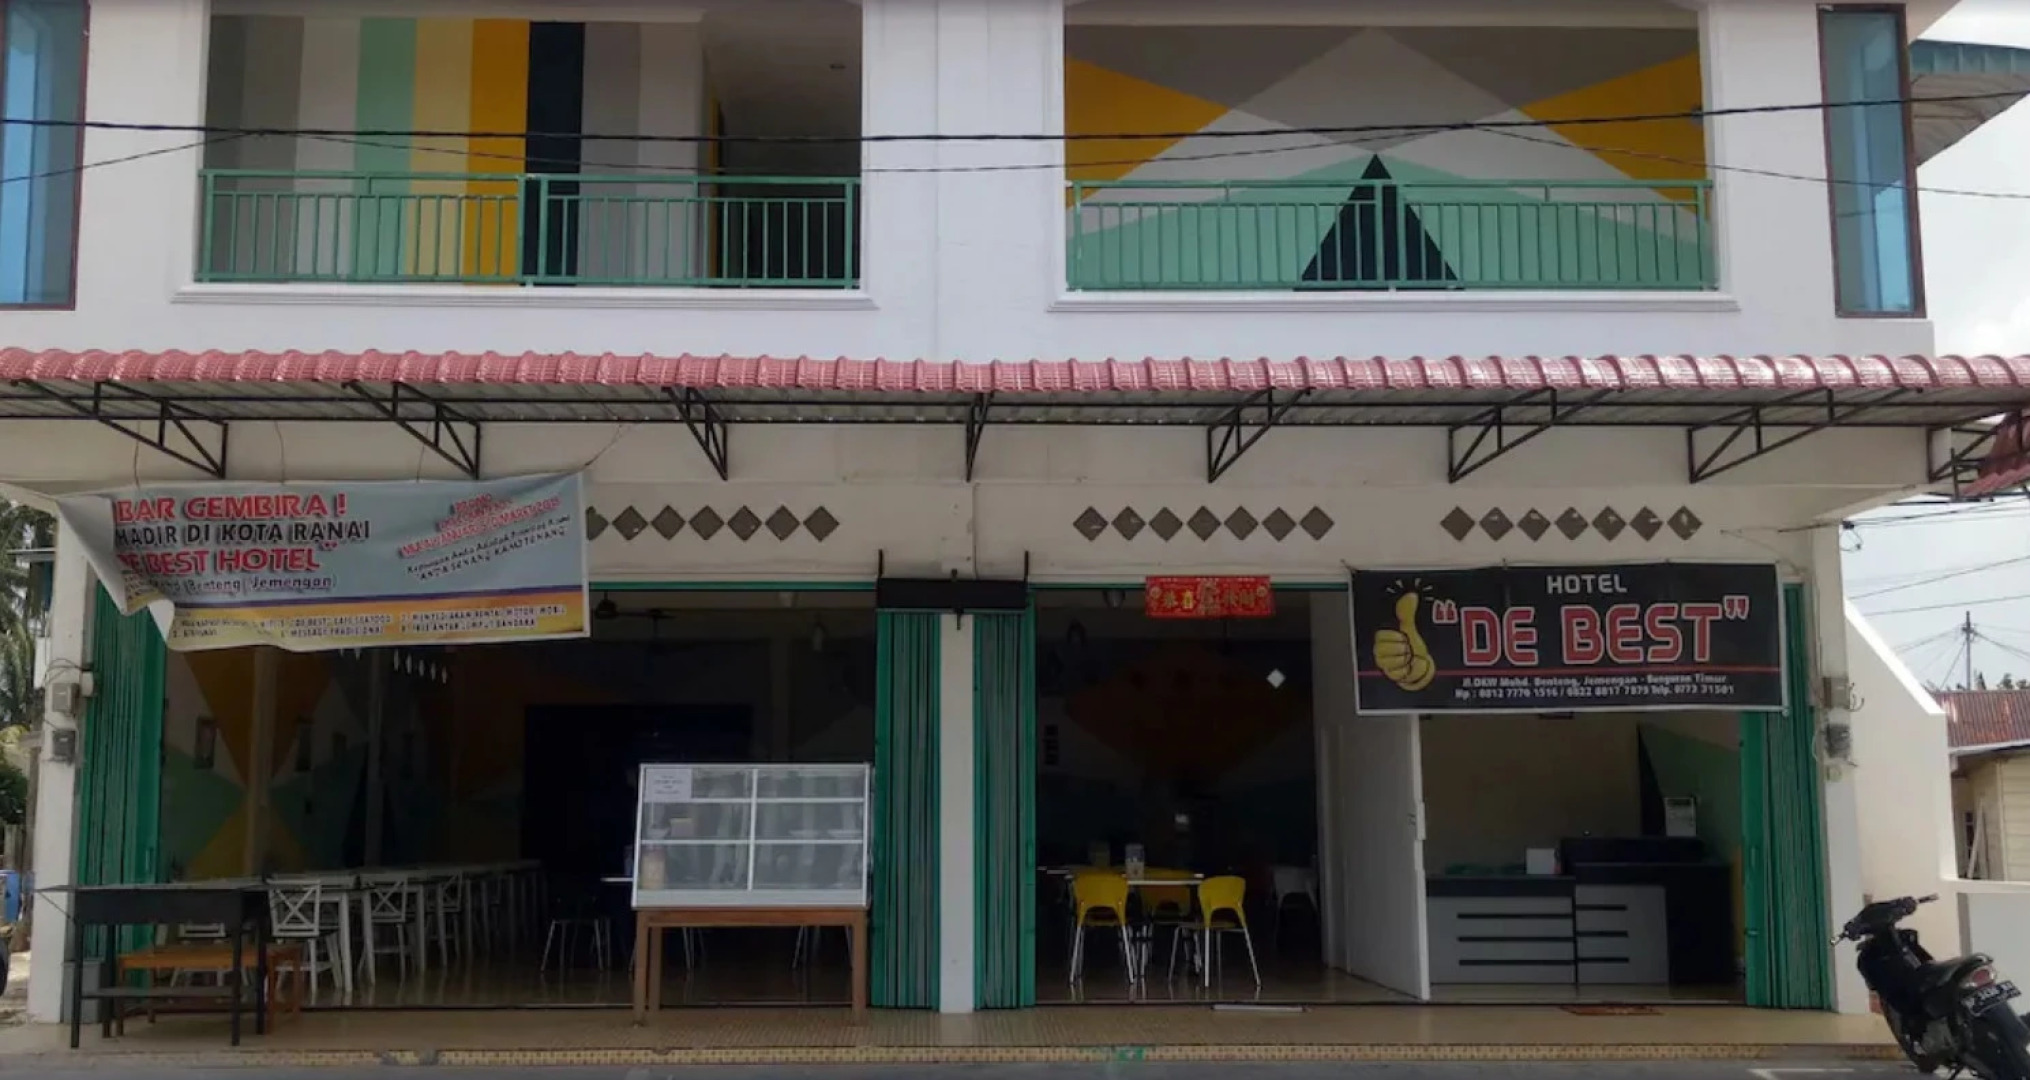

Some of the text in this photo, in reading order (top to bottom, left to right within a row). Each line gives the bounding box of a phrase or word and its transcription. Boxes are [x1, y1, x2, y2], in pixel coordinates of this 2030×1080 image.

[116, 498, 176, 523] BAR
[184, 494, 330, 520] GEMBIRA
[187, 523, 211, 543] DI
[221, 521, 283, 542] KOTA
[293, 519, 371, 541] RANAI
[144, 549, 211, 575] BEST
[1546, 573, 1629, 595] HOTEL
[1695, 673, 1727, 683] Timur
